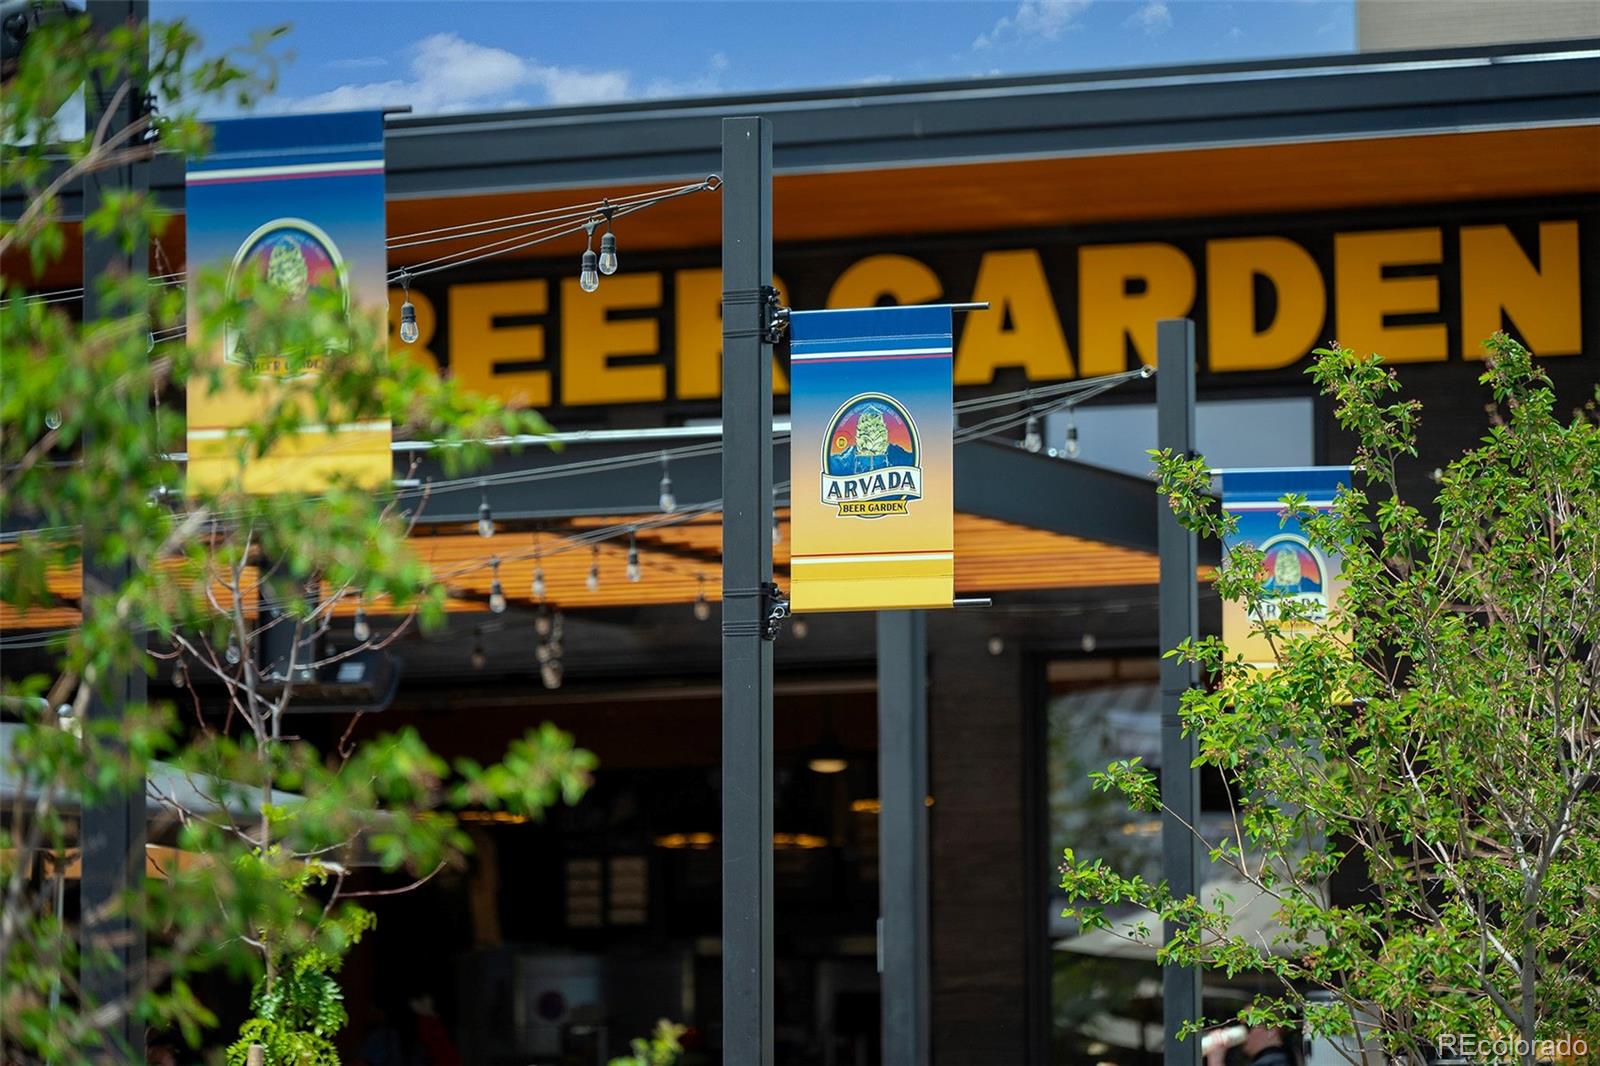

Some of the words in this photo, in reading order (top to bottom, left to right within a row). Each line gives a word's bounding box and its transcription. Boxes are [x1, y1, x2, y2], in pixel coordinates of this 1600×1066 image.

[827, 471, 917, 500] ARVADA
[843, 503, 866, 513] BEER
[868, 502, 904, 512] GARDEN
